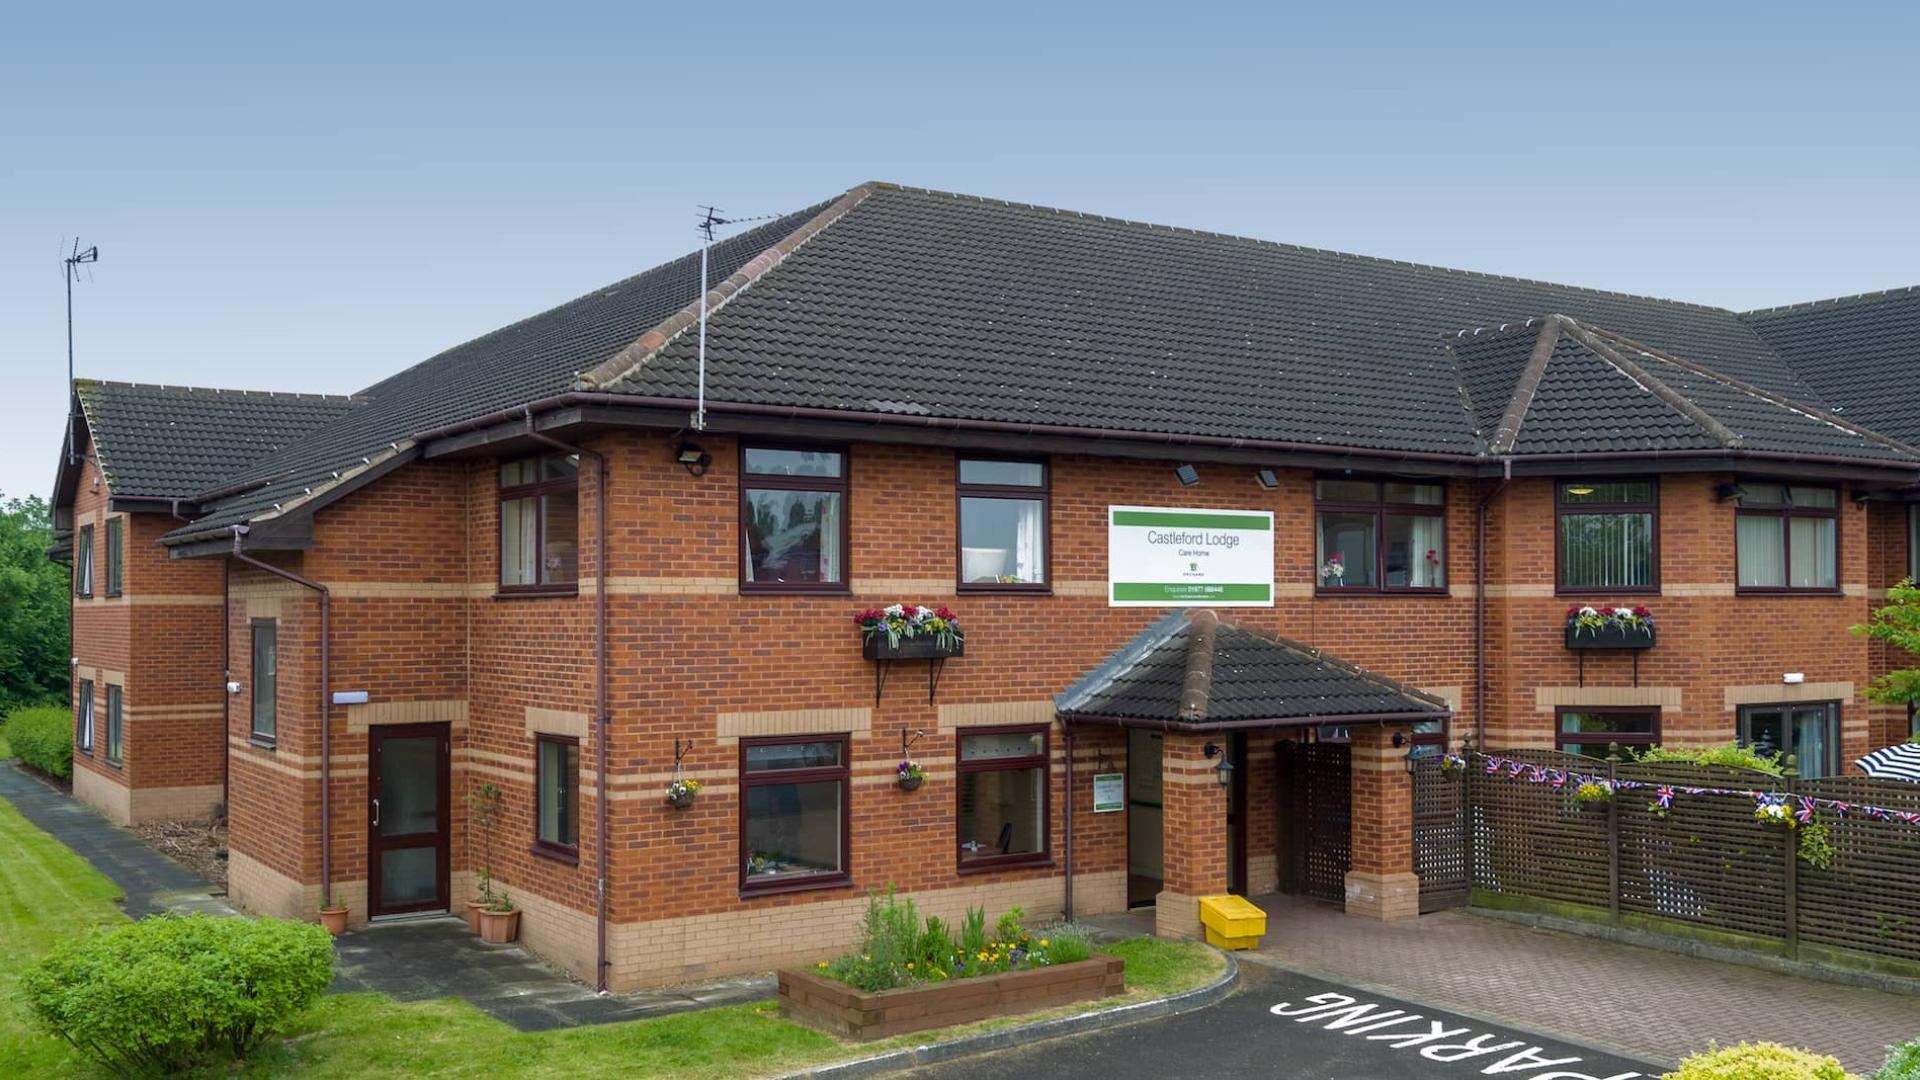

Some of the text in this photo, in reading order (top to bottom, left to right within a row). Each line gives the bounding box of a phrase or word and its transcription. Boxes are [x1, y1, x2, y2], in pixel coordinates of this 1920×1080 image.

[1147, 530, 1240, 548] Castleford Lodge
[1178, 549, 1209, 557] Care Home
